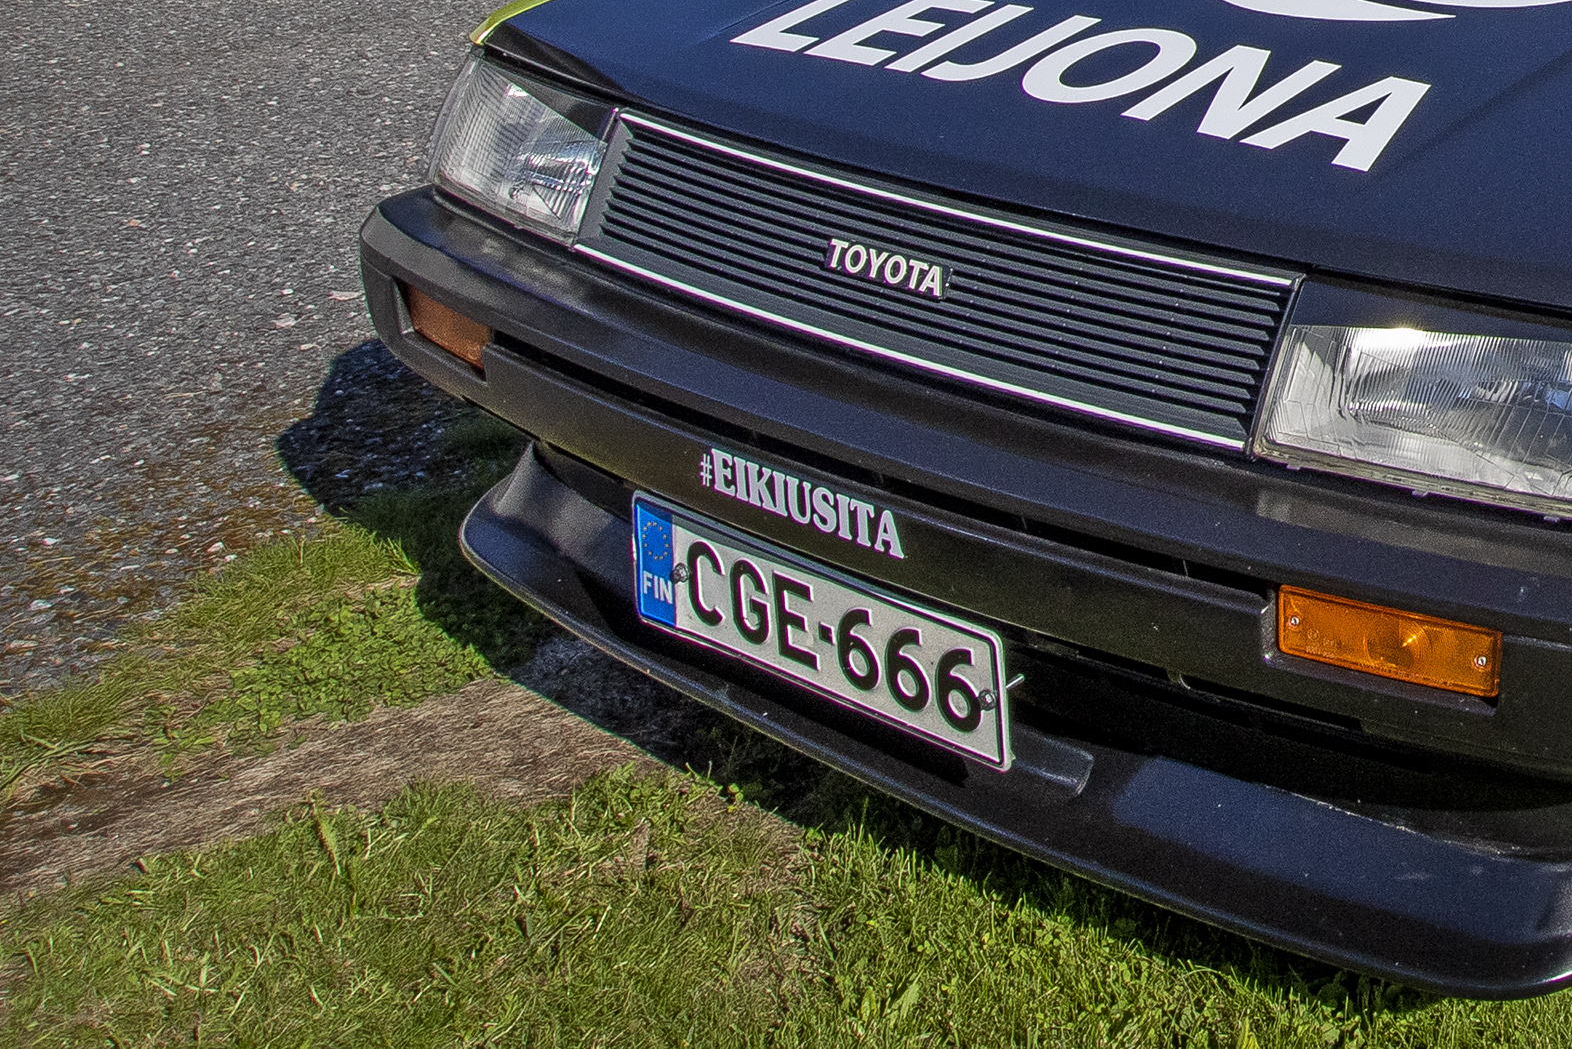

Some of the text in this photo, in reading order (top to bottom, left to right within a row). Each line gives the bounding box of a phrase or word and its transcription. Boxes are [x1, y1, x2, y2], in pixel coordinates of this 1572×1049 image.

[827, 237, 945, 299] TOYOTA
[700, 448, 905, 559] #EIKIUSITA
[642, 540, 982, 733] FIN CGE-666
